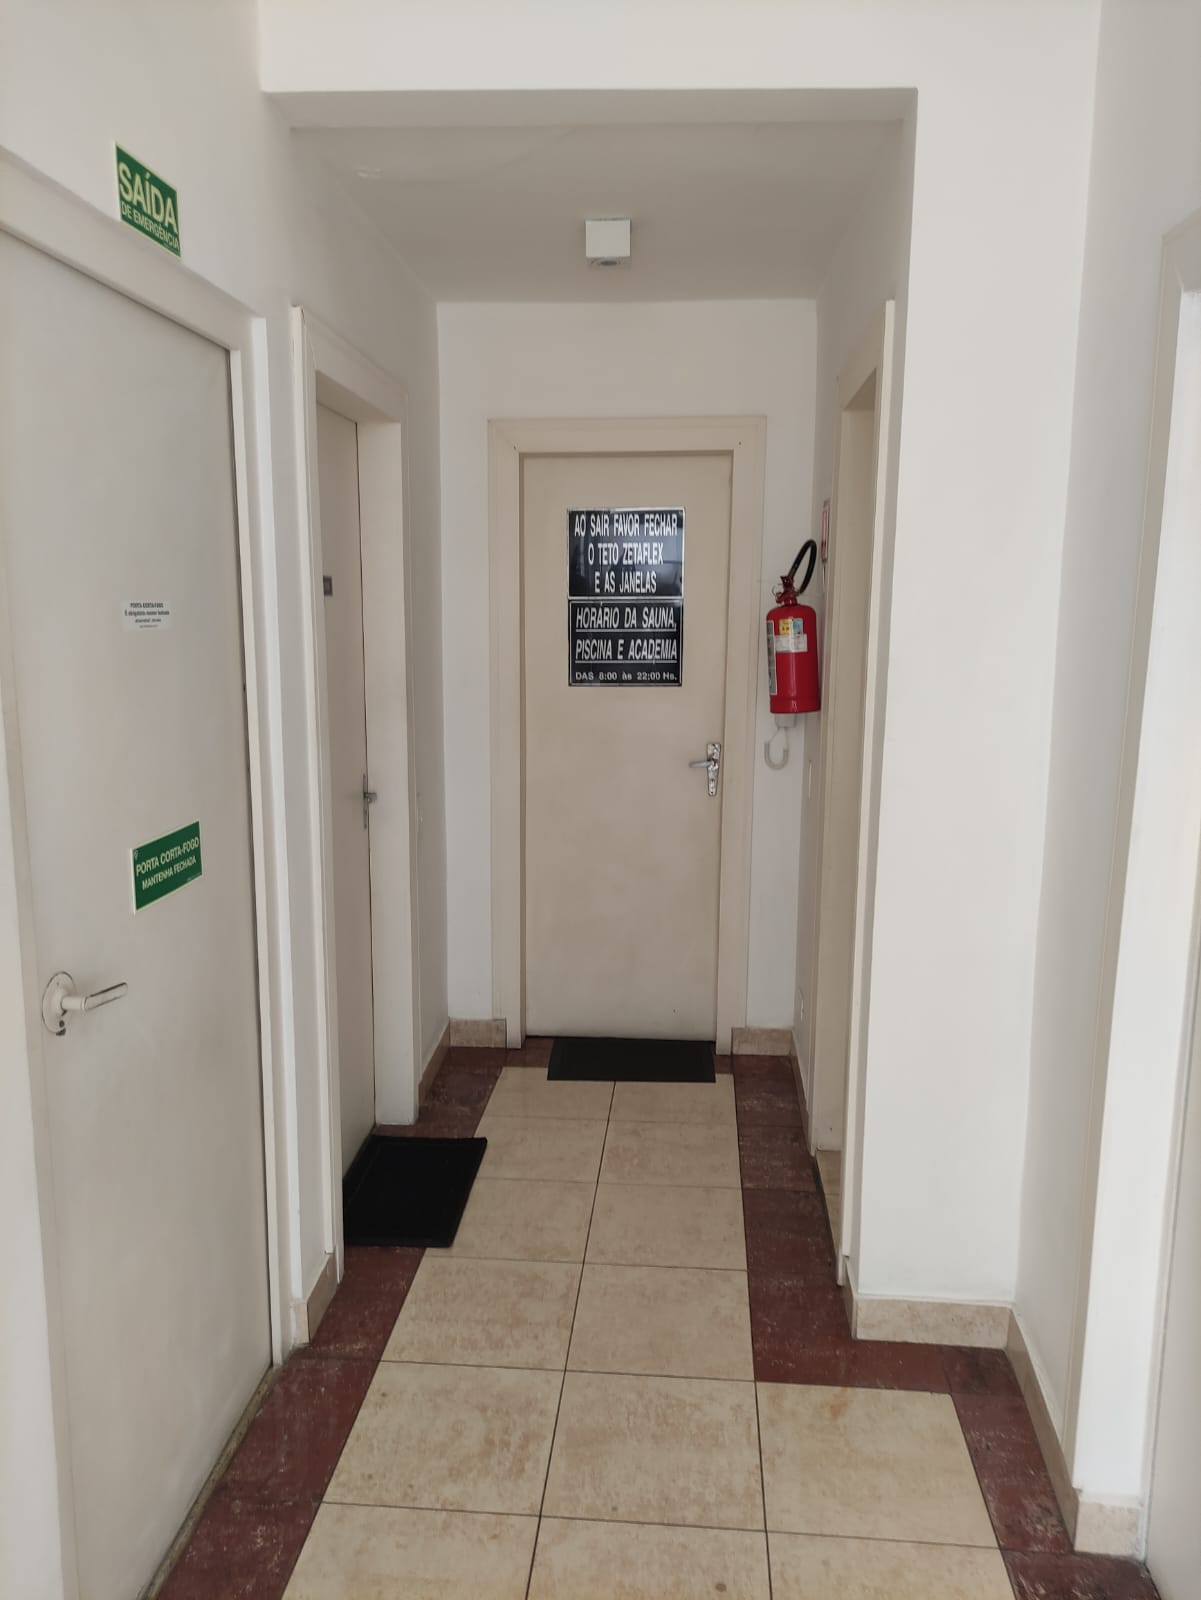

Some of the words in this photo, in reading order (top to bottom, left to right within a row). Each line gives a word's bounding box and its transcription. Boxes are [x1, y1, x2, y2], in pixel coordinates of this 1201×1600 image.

[119, 161, 178, 235] SAÍDA
[121, 200, 132, 220] DE
[133, 208, 179, 250] EMERGÊNCIA
[574, 514, 586, 537] AO
[590, 514, 610, 537] SAIR
[613, 513, 640, 537] FAVOR
[644, 513, 678, 537] FECHAR
[588, 542, 595, 566] O
[598, 542, 619, 566] TETO
[622, 542, 664, 566] ZETAFLEX
[594, 571, 600, 594] E
[604, 571, 616, 594] AS
[619, 571, 657, 594] JANELAS
[576, 601, 619, 629] HORÁRIO
[624, 606, 637, 629] DA
[575, 638, 612, 660] PISCINA
[617, 638, 624, 660] E
[628, 638, 677, 660] ACADEMIA
[575, 671, 594, 681] DAS
[637, 671, 661, 681] 22:00
[663, 671, 678, 681] Hs.
[136, 855, 160, 877] PORTA
[160, 836, 200, 865] CORTA-FOGO
[142, 865, 174, 891] MANTENHA
[173, 855, 197, 875] FECHADA
